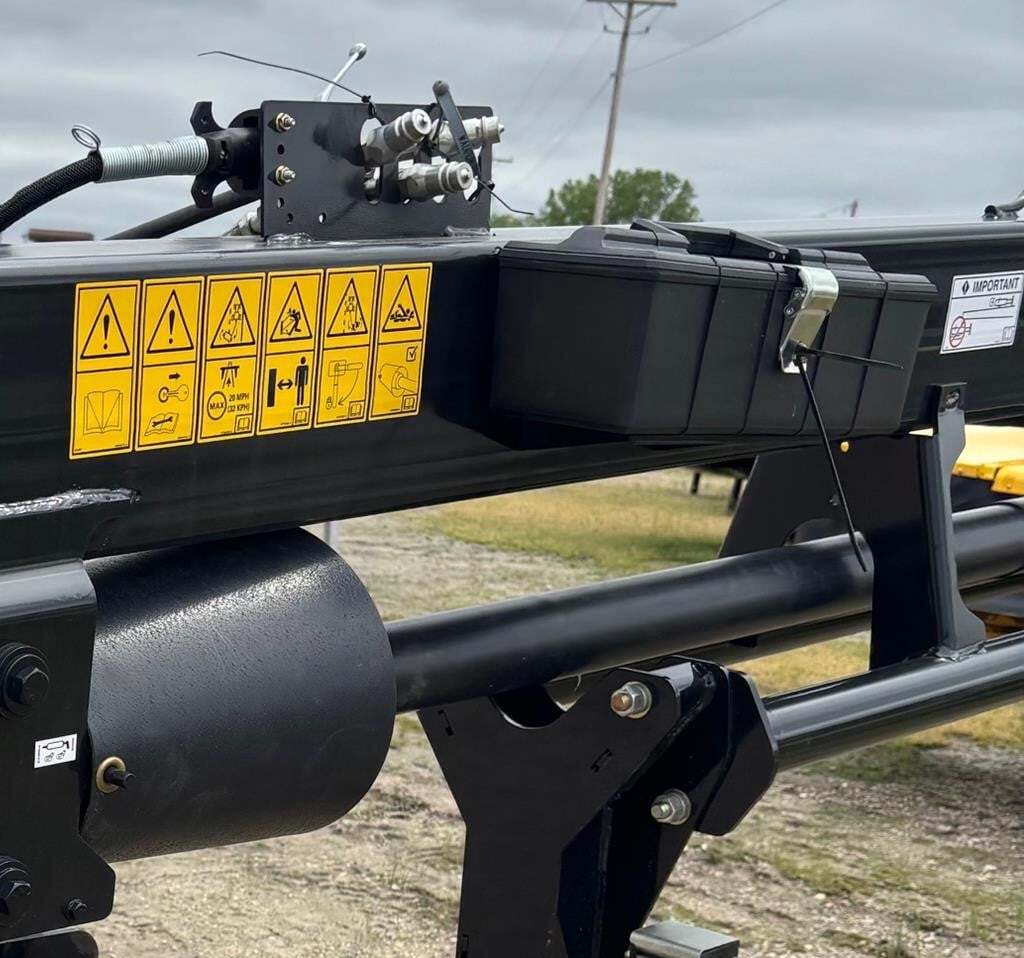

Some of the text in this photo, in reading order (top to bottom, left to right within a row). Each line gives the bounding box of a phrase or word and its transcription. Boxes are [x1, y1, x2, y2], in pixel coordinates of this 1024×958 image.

[973, 278, 1020, 293] IMPORTANT
[229, 393, 250, 402] 20 MPH
